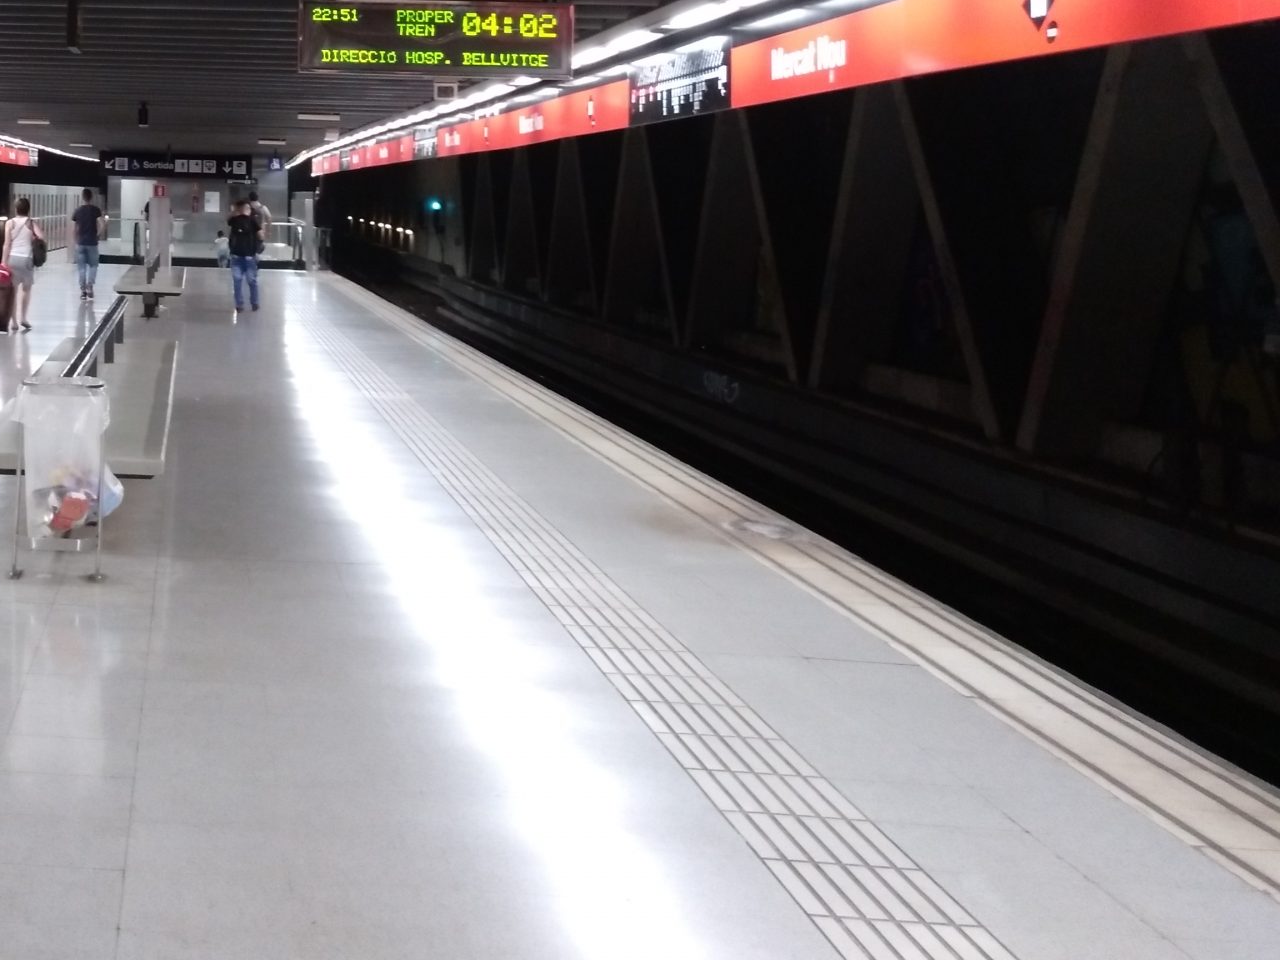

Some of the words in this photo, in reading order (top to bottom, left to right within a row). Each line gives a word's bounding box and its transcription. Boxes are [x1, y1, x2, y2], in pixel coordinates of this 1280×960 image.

[312, 8, 358, 22] 22:51
[396, 9, 454, 23] PROPER
[396, 23, 435, 36] TREN
[462, 13, 558, 38] 04:02
[405, 51, 451, 65] HOSP.
[462, 52, 548, 67] BELLVITGE
[143, 160, 174, 170] Sortida
